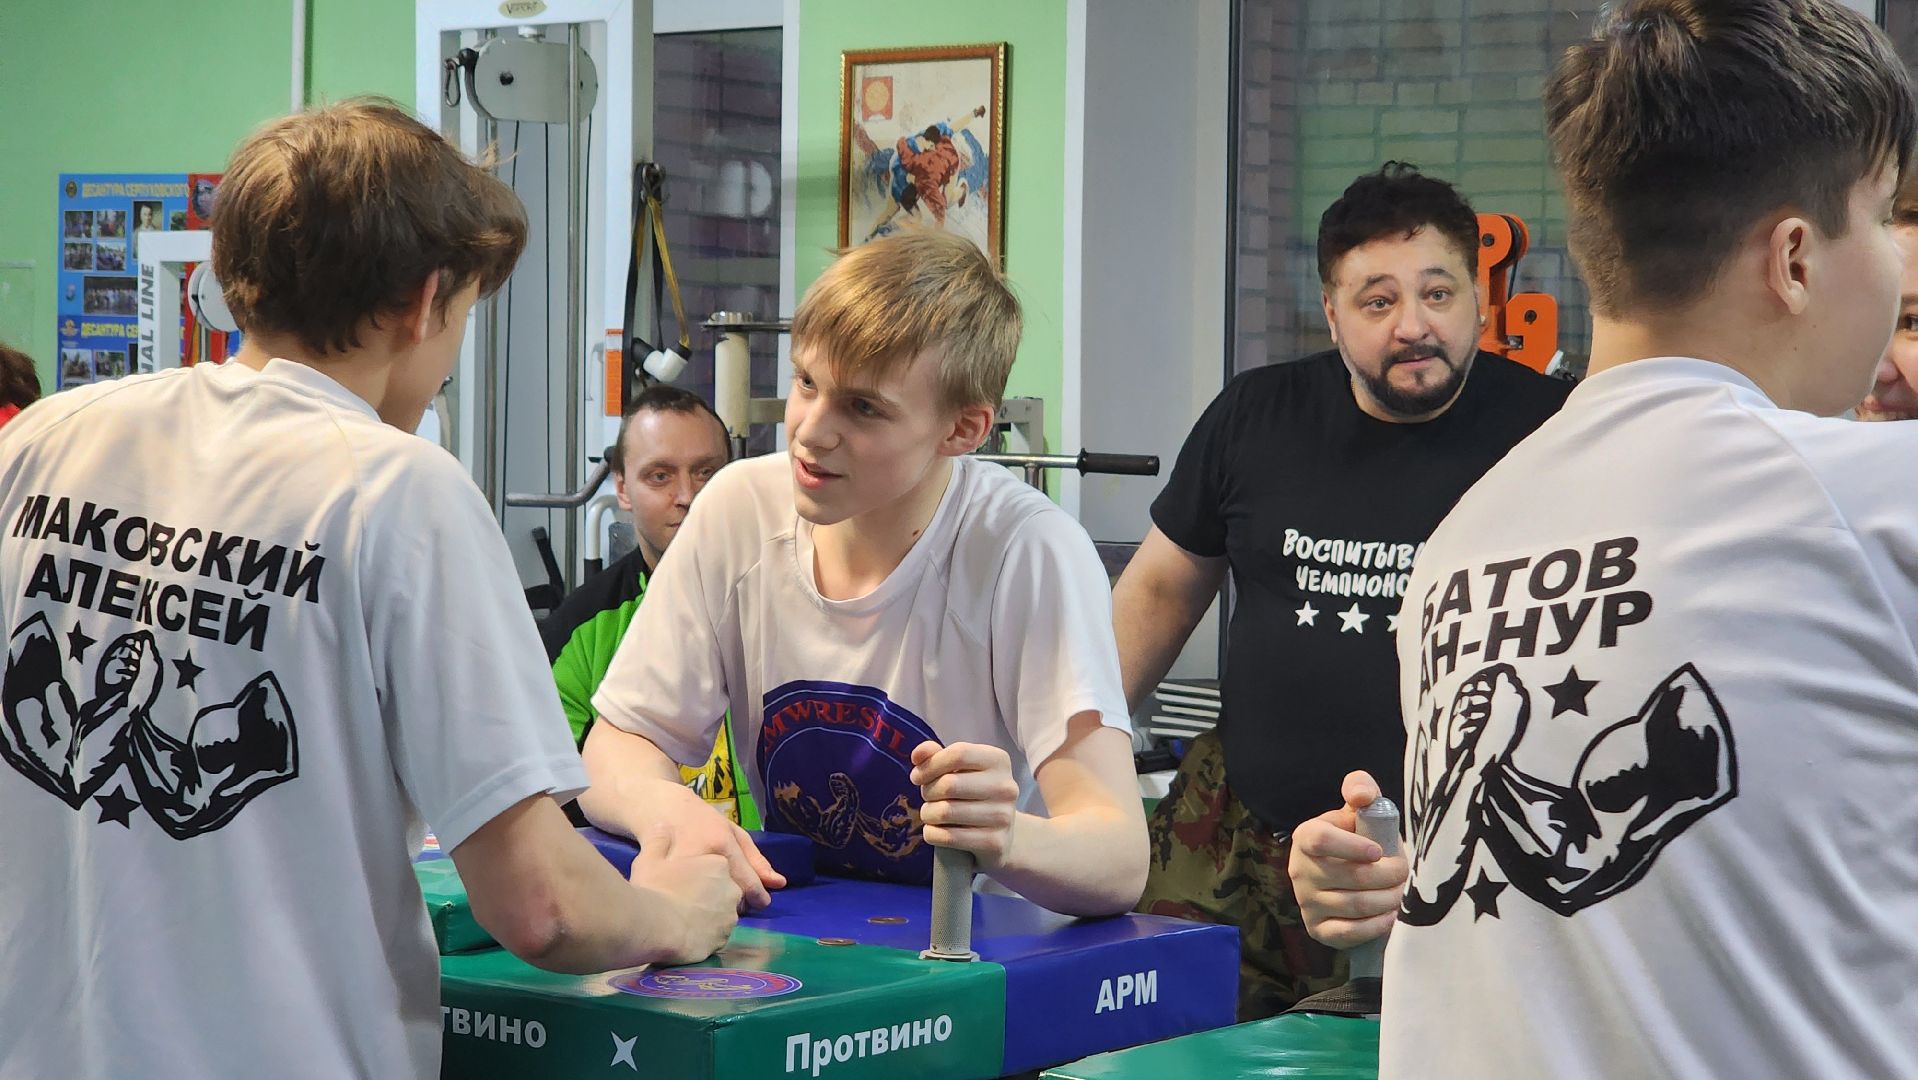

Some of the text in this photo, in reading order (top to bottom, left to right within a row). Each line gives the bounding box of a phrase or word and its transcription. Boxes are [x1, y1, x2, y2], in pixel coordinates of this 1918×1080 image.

[141, 263, 154, 320] LINE
[12, 495, 325, 603] МАКОВСКИЙ
[24, 553, 270, 652] АЛЕКСЕЙ
[1094, 969, 1157, 1014] АРМ
[785, 1014, 952, 1077] Протвино
